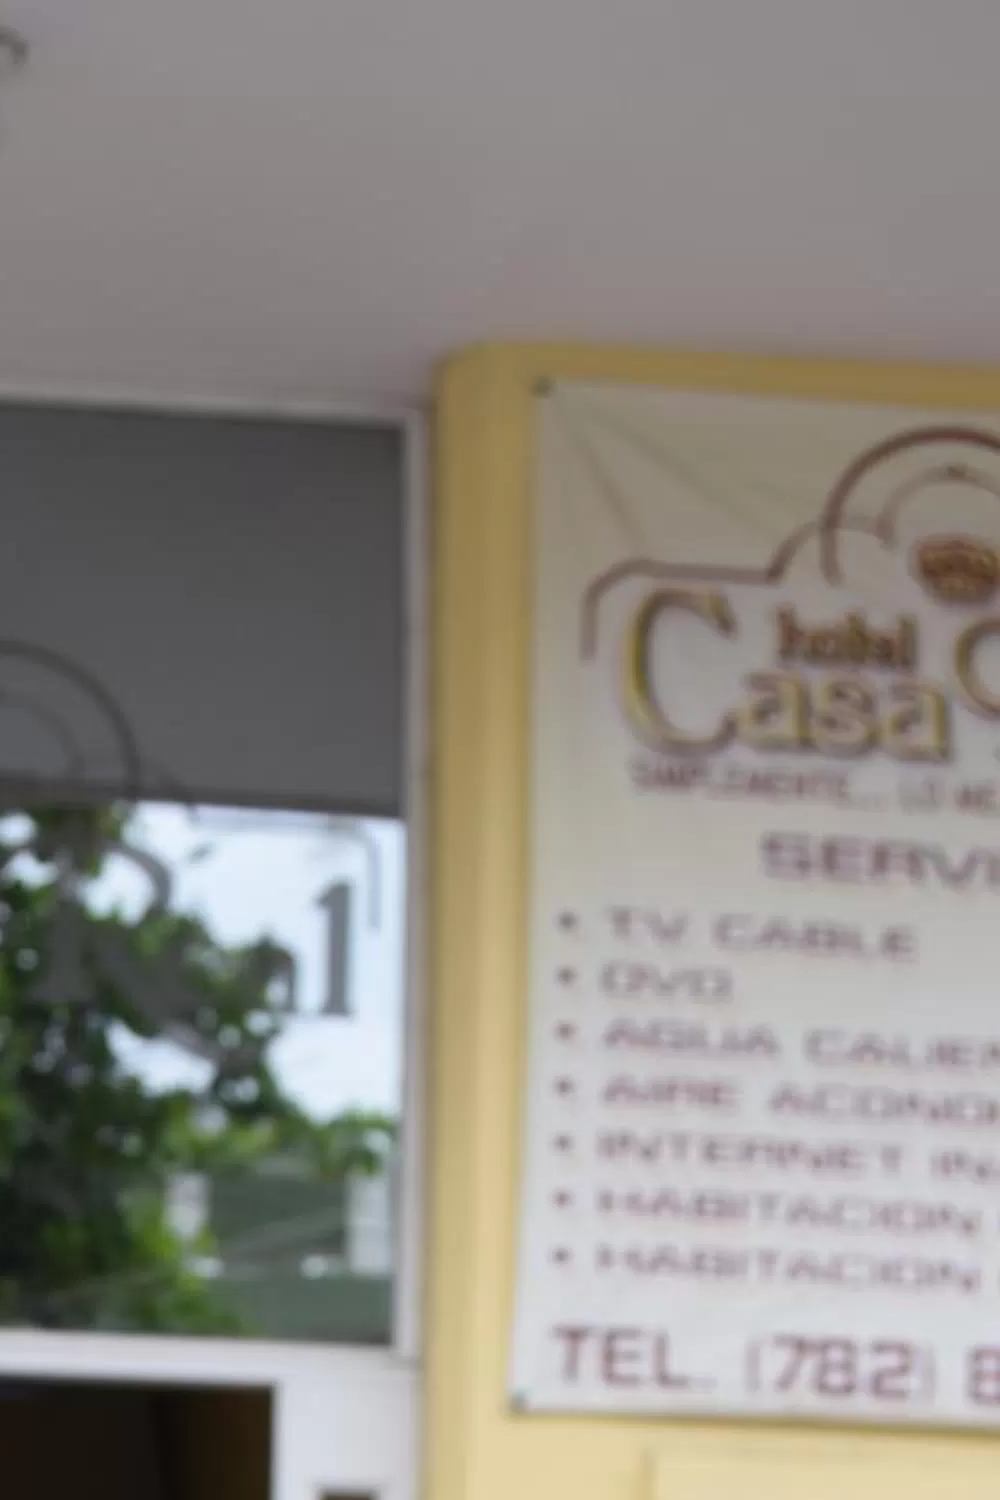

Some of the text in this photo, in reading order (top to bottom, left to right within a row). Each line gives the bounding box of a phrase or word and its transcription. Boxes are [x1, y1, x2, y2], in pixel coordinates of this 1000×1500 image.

[778, 605, 915, 669] hotel
[623, 588, 952, 765] Casa
[605, 905, 918, 962] TV CABLE
[600, 961, 733, 1000] DVD
[602, 1016, 783, 1059] AGUA
[602, 1074, 742, 1114] AIRE
[597, 1134, 902, 1177] INTERNET
[597, 1189, 980, 1234] HABITACION
[596, 1242, 980, 1292] HABITACION
[552, 1325, 716, 1392] TEL.
[744, 1335, 936, 1403] (782)
